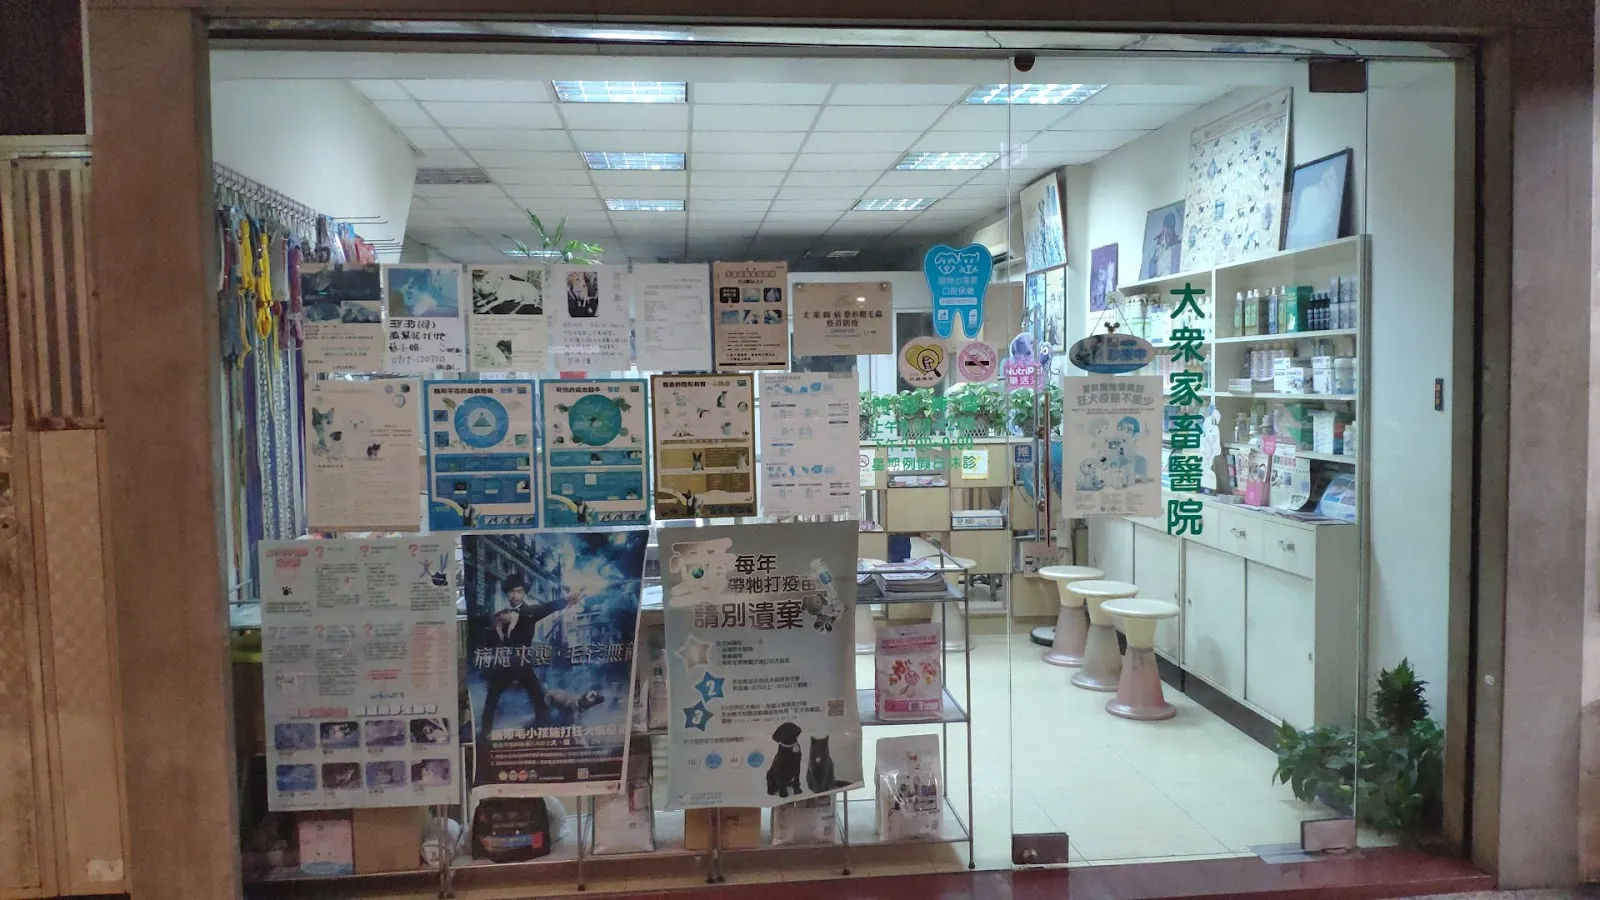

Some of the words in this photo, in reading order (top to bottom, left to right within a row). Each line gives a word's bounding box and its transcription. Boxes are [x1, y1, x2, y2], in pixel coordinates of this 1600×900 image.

[1015, 445, 1030, 457] 推
[735, 553, 777, 574] 每年
[693, 600, 804, 631] 請別遺棄
[706, 680, 717, 697] 2
[691, 709, 701, 725] 3
